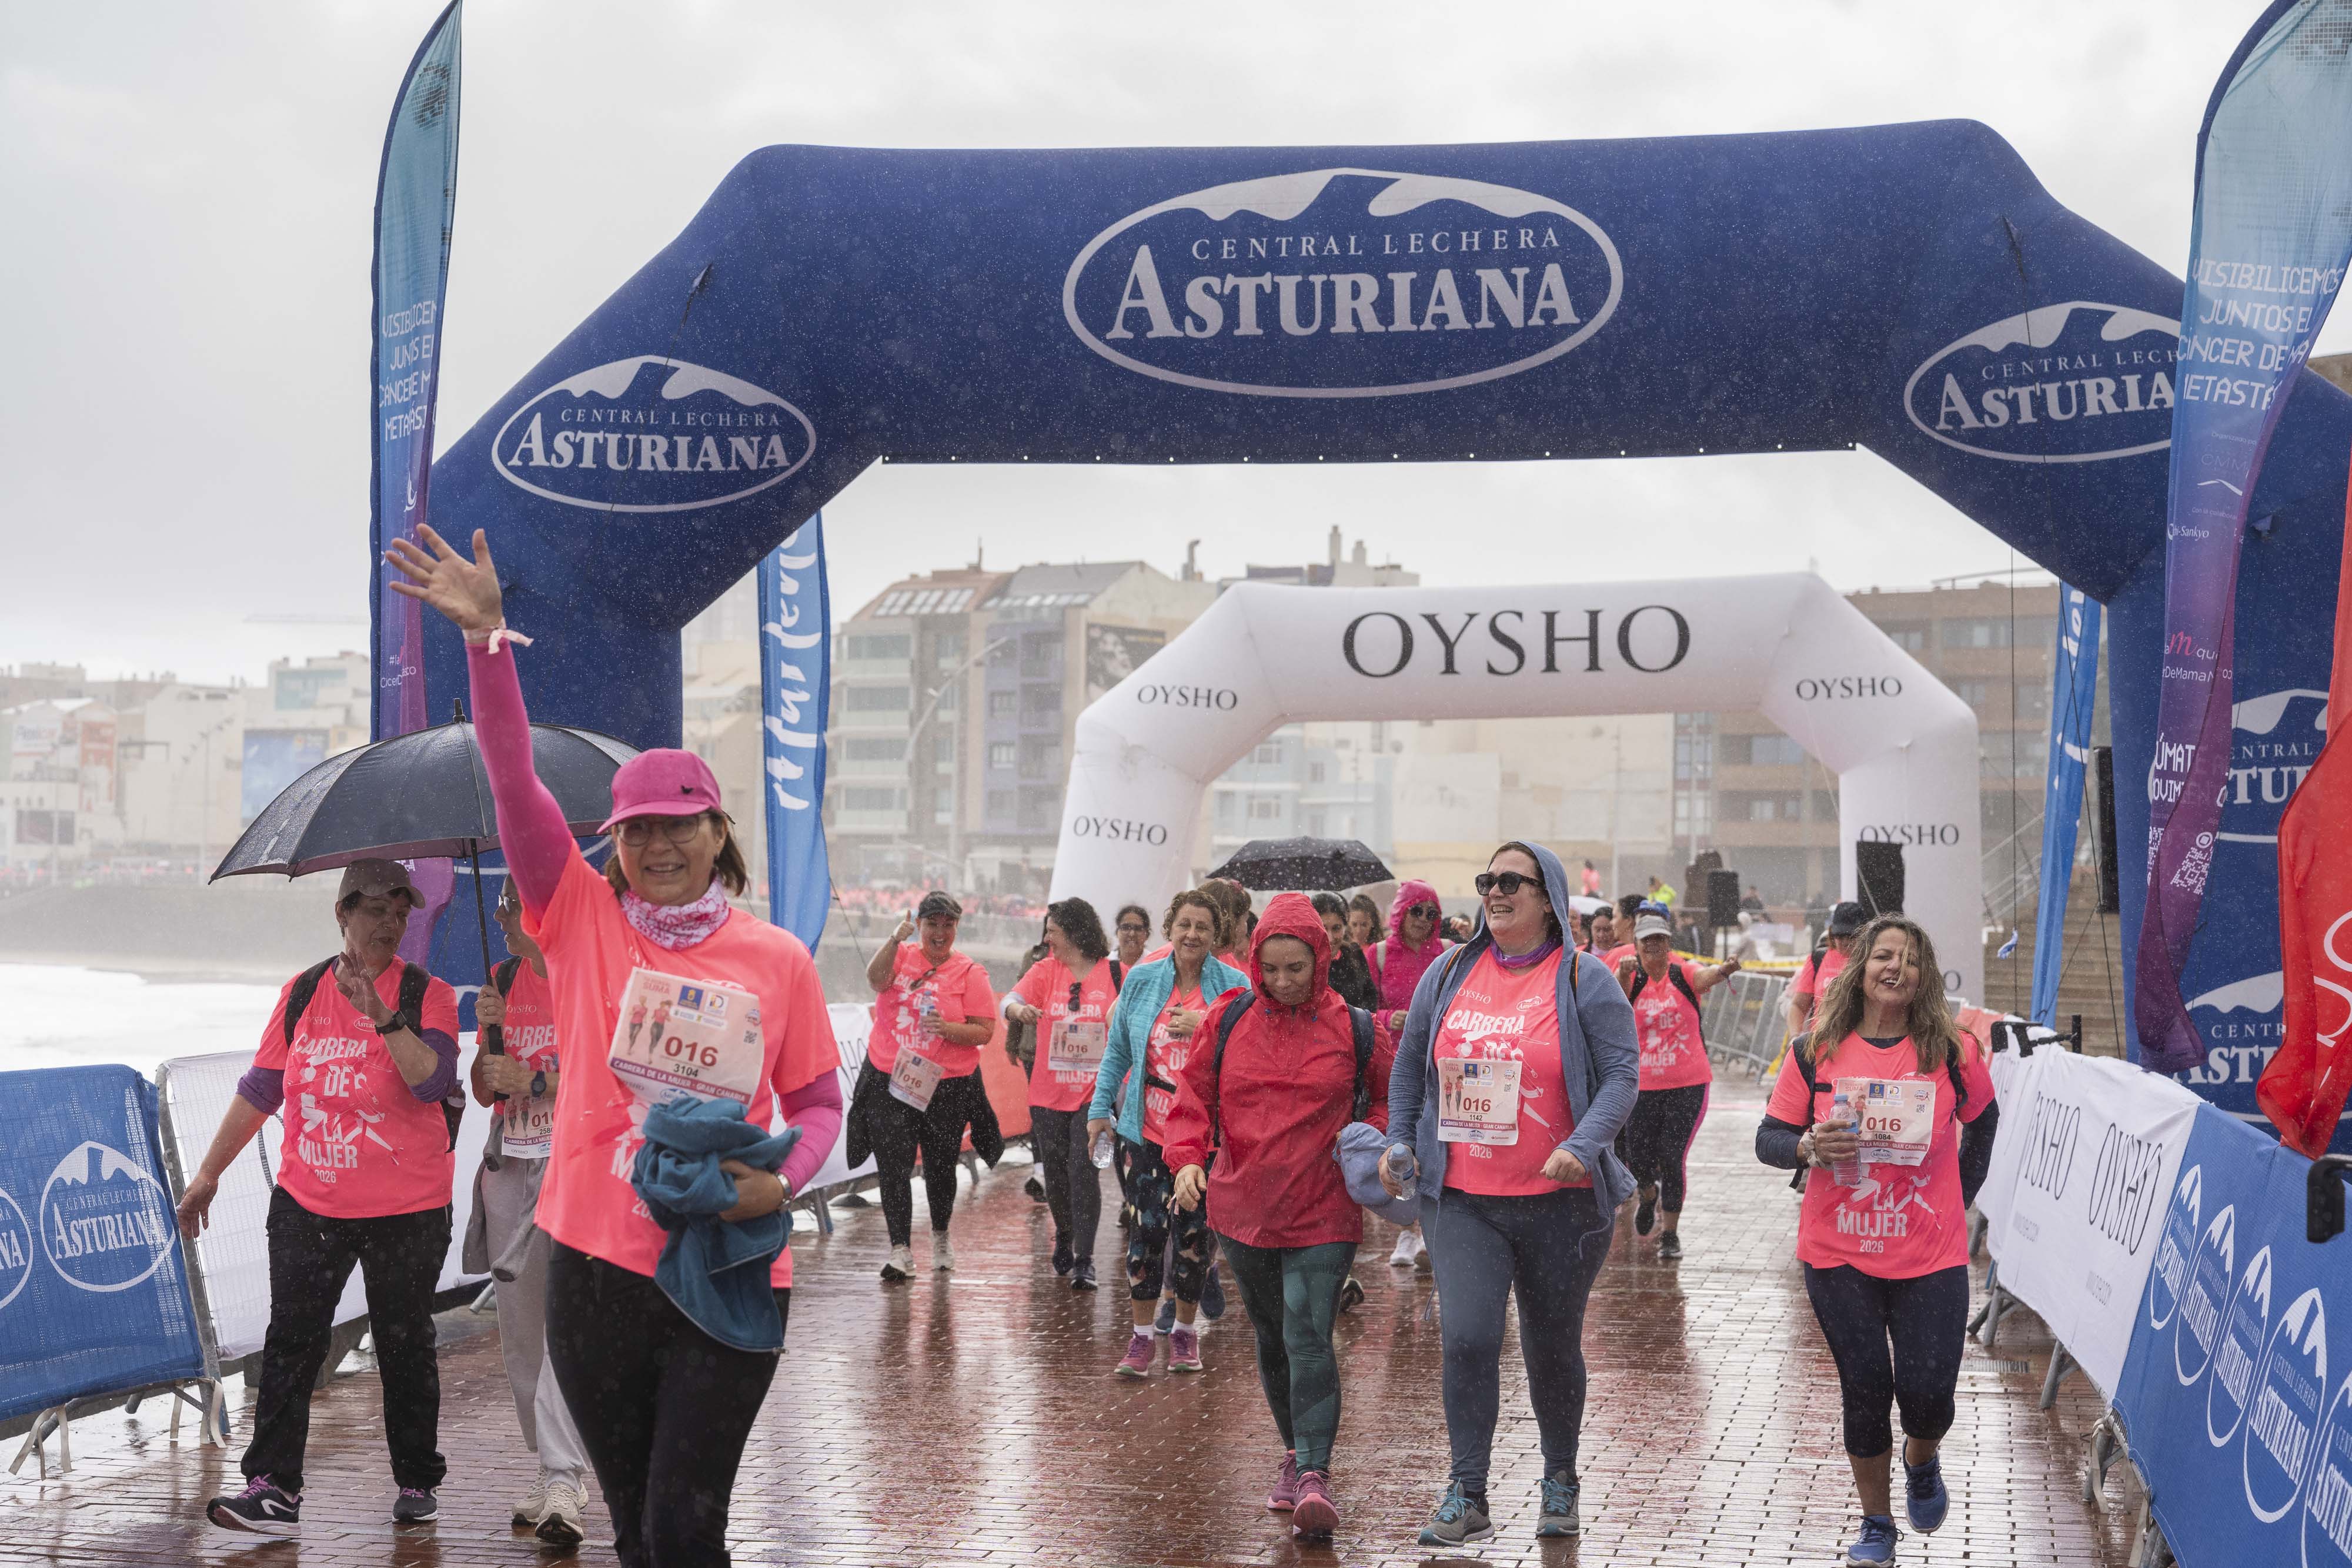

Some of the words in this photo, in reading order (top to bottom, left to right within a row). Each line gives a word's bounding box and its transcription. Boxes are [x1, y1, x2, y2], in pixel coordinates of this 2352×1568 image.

[1191, 235, 1363, 260] CENTRAL
[1384, 226, 1561, 255] LECHERA
[1105, 243, 1581, 340] ASTURIANA
[2200, 299, 2294, 332] JUNTOS
[1982, 354, 2103, 381] CENTRAL
[561, 409, 659, 429] CENTRAL
[670, 409, 781, 427] LECHERA
[507, 412, 791, 471] ASTURIANA
[1342, 606, 1690, 678] OYSHO
[1137, 683, 1238, 711] OYSHO
[1796, 676, 1903, 701] OYSHO
[1073, 814, 1168, 847] OYSHO
[1860, 823, 1960, 847] OYSHO
[1457, 987, 1491, 1004] OYSHO
[506, 1004, 537, 1014] OYSHO
[1447, 1009, 1525, 1035] CARRERA
[295, 1033, 369, 1058] CARRERA
[664, 1036, 719, 1067] 016
[1067, 1044, 1088, 1054] 016
[673, 1063, 699, 1078] 3104
[1641, 1051, 1676, 1067] MUJER
[324, 1065, 354, 1097] DE
[613, 1059, 646, 1076] CARRERA
[647, 1068, 657, 1079] DE
[657, 1070, 667, 1081] LA
[668, 1072, 690, 1086] MUJER
[696, 1082, 716, 1095] GRAN
[717, 1087, 746, 1102] CANARIA
[903, 1074, 923, 1088] 016
[1463, 1097, 1492, 1112] 016
[1866, 1116, 1902, 1132] 016
[299, 1138, 358, 1168] MUJER
[1469, 1144, 1492, 1159] 2026
[66, 1194, 108, 1211] CENTRAL
[55, 1203, 163, 1260] ASTURIANA
[1837, 1209, 1908, 1238] MUJER
[1859, 1239, 1884, 1253] 2026
[2250, 1350, 2310, 1486] ASTURIANA
